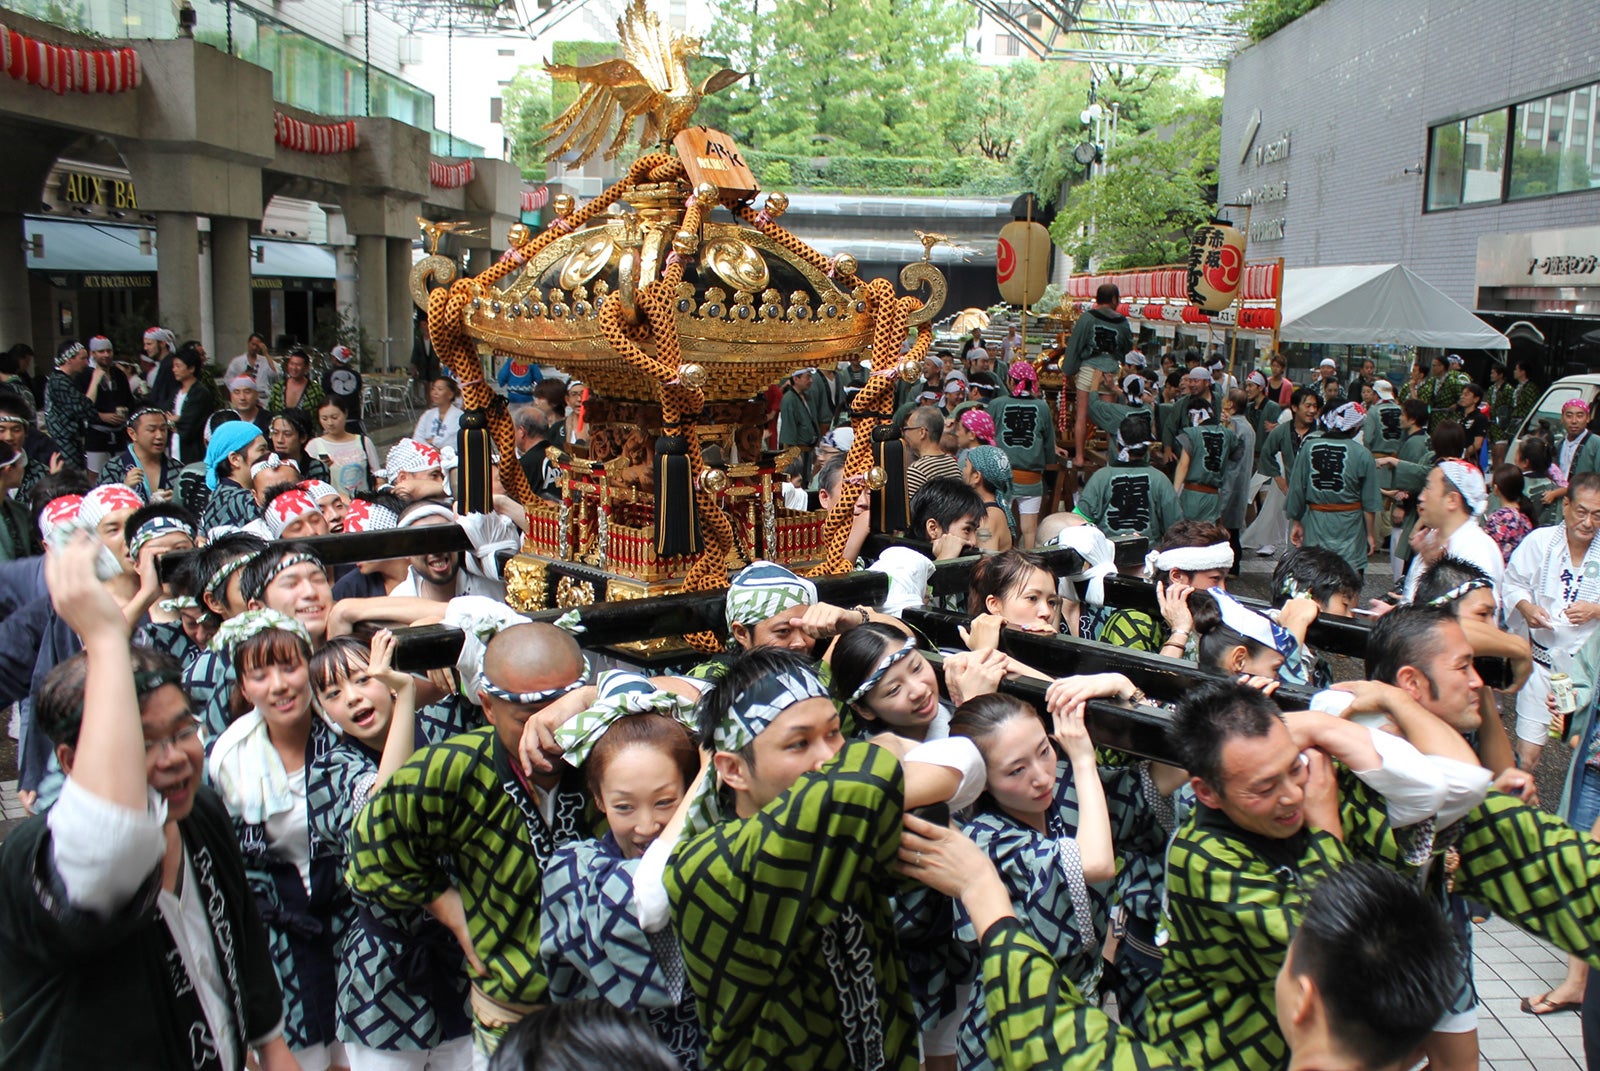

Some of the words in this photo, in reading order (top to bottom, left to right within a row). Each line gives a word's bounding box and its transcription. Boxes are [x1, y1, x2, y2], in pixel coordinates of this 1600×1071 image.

[706, 139, 744, 167] ARK
[66, 173, 103, 205] AUX
[1526, 254, 1600, 276] アーク放送センタ
